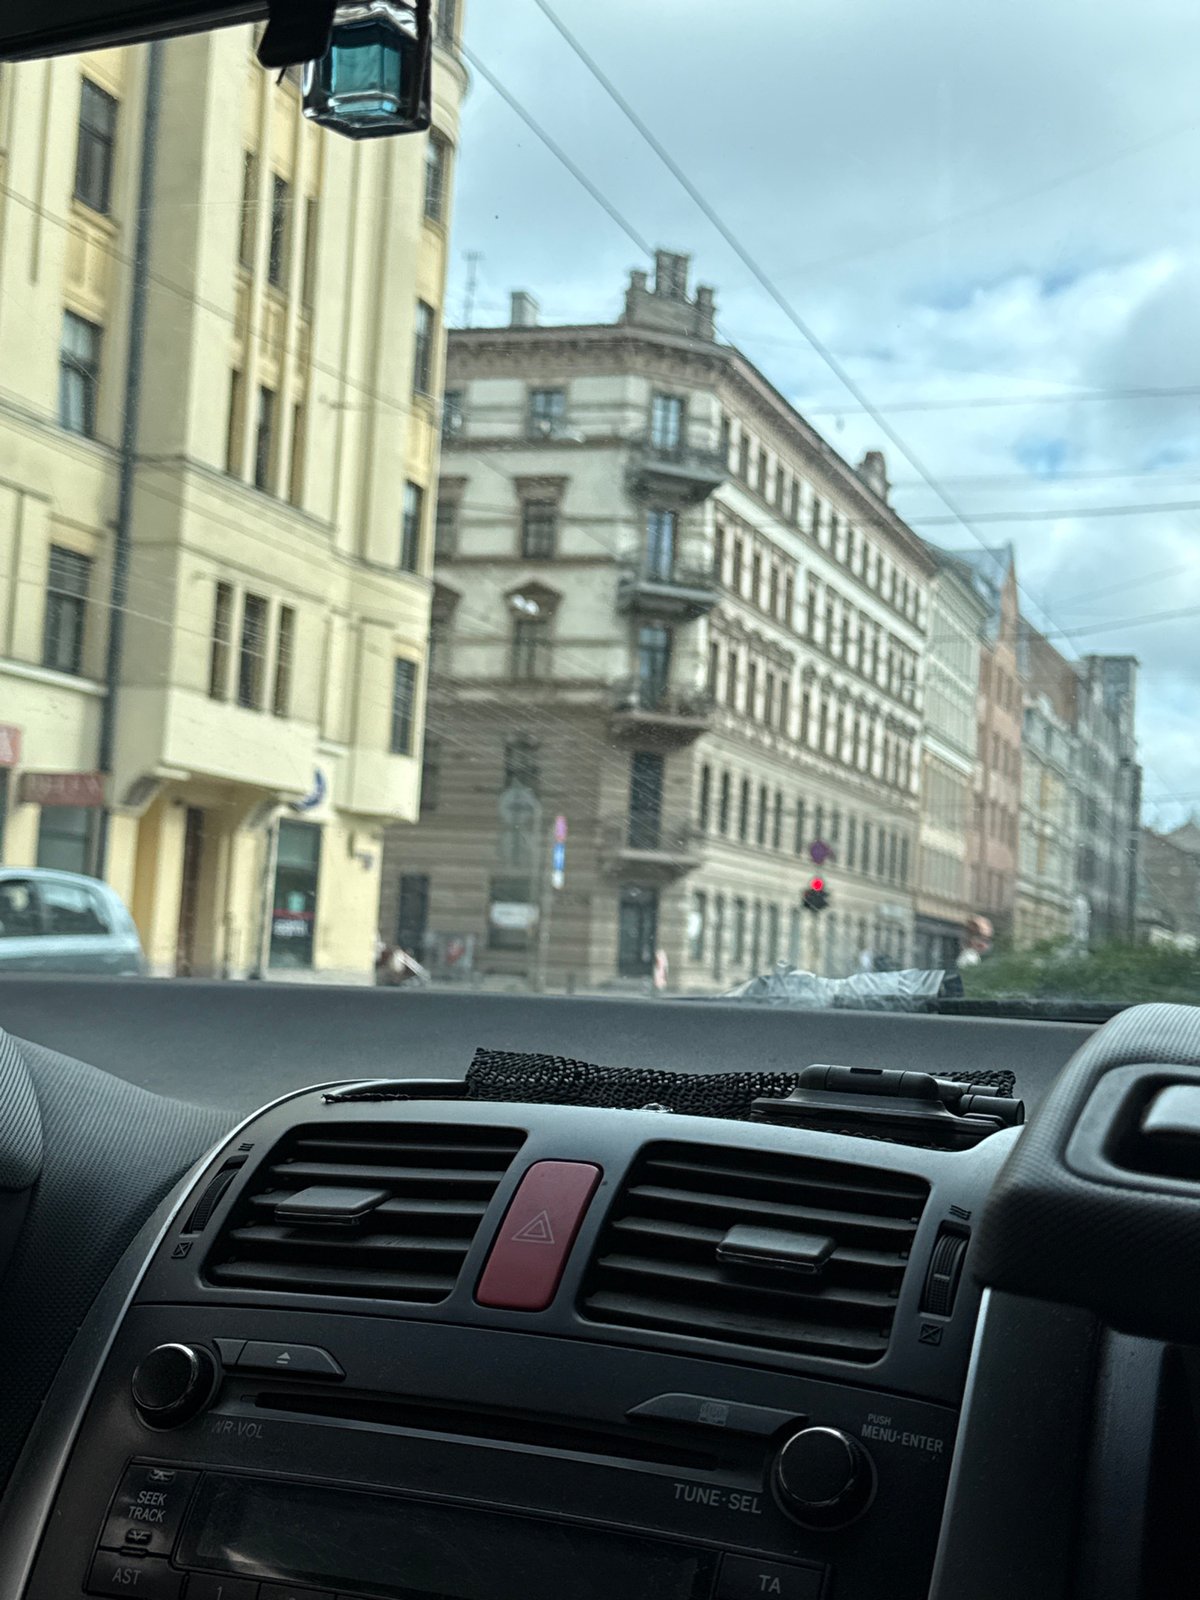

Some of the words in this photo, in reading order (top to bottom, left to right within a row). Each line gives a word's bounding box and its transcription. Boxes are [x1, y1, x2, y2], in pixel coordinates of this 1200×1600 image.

[867, 1413, 892, 1425] PUSH
[137, 1490, 167, 1506] SEEK
[128, 1506, 167, 1524] TRACK
[112, 1567, 141, 1585] AST
[758, 1574, 781, 1594] TA
